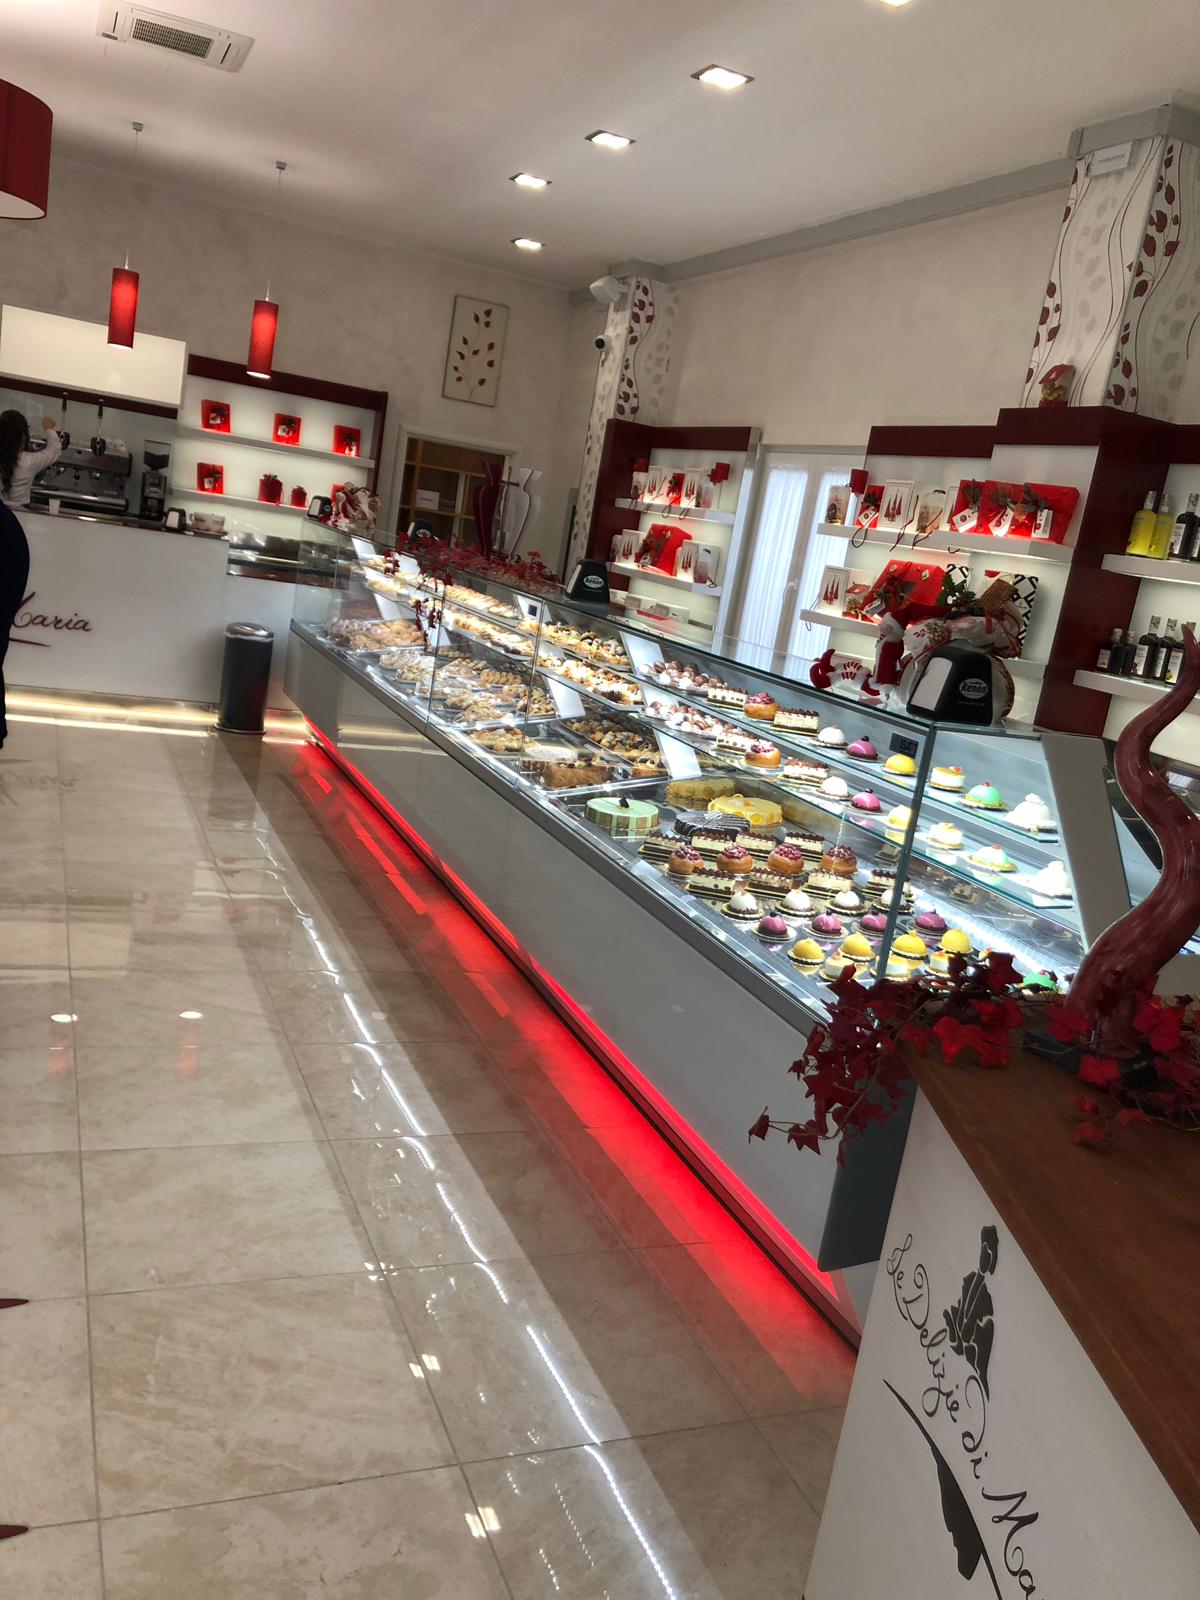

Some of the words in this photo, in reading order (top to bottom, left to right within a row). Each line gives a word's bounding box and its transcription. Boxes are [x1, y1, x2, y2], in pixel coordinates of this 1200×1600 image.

[902, 1264, 960, 1422] Delizie
[962, 1375, 988, 1480] Di
[982, 1487, 1040, 1600] Ma
